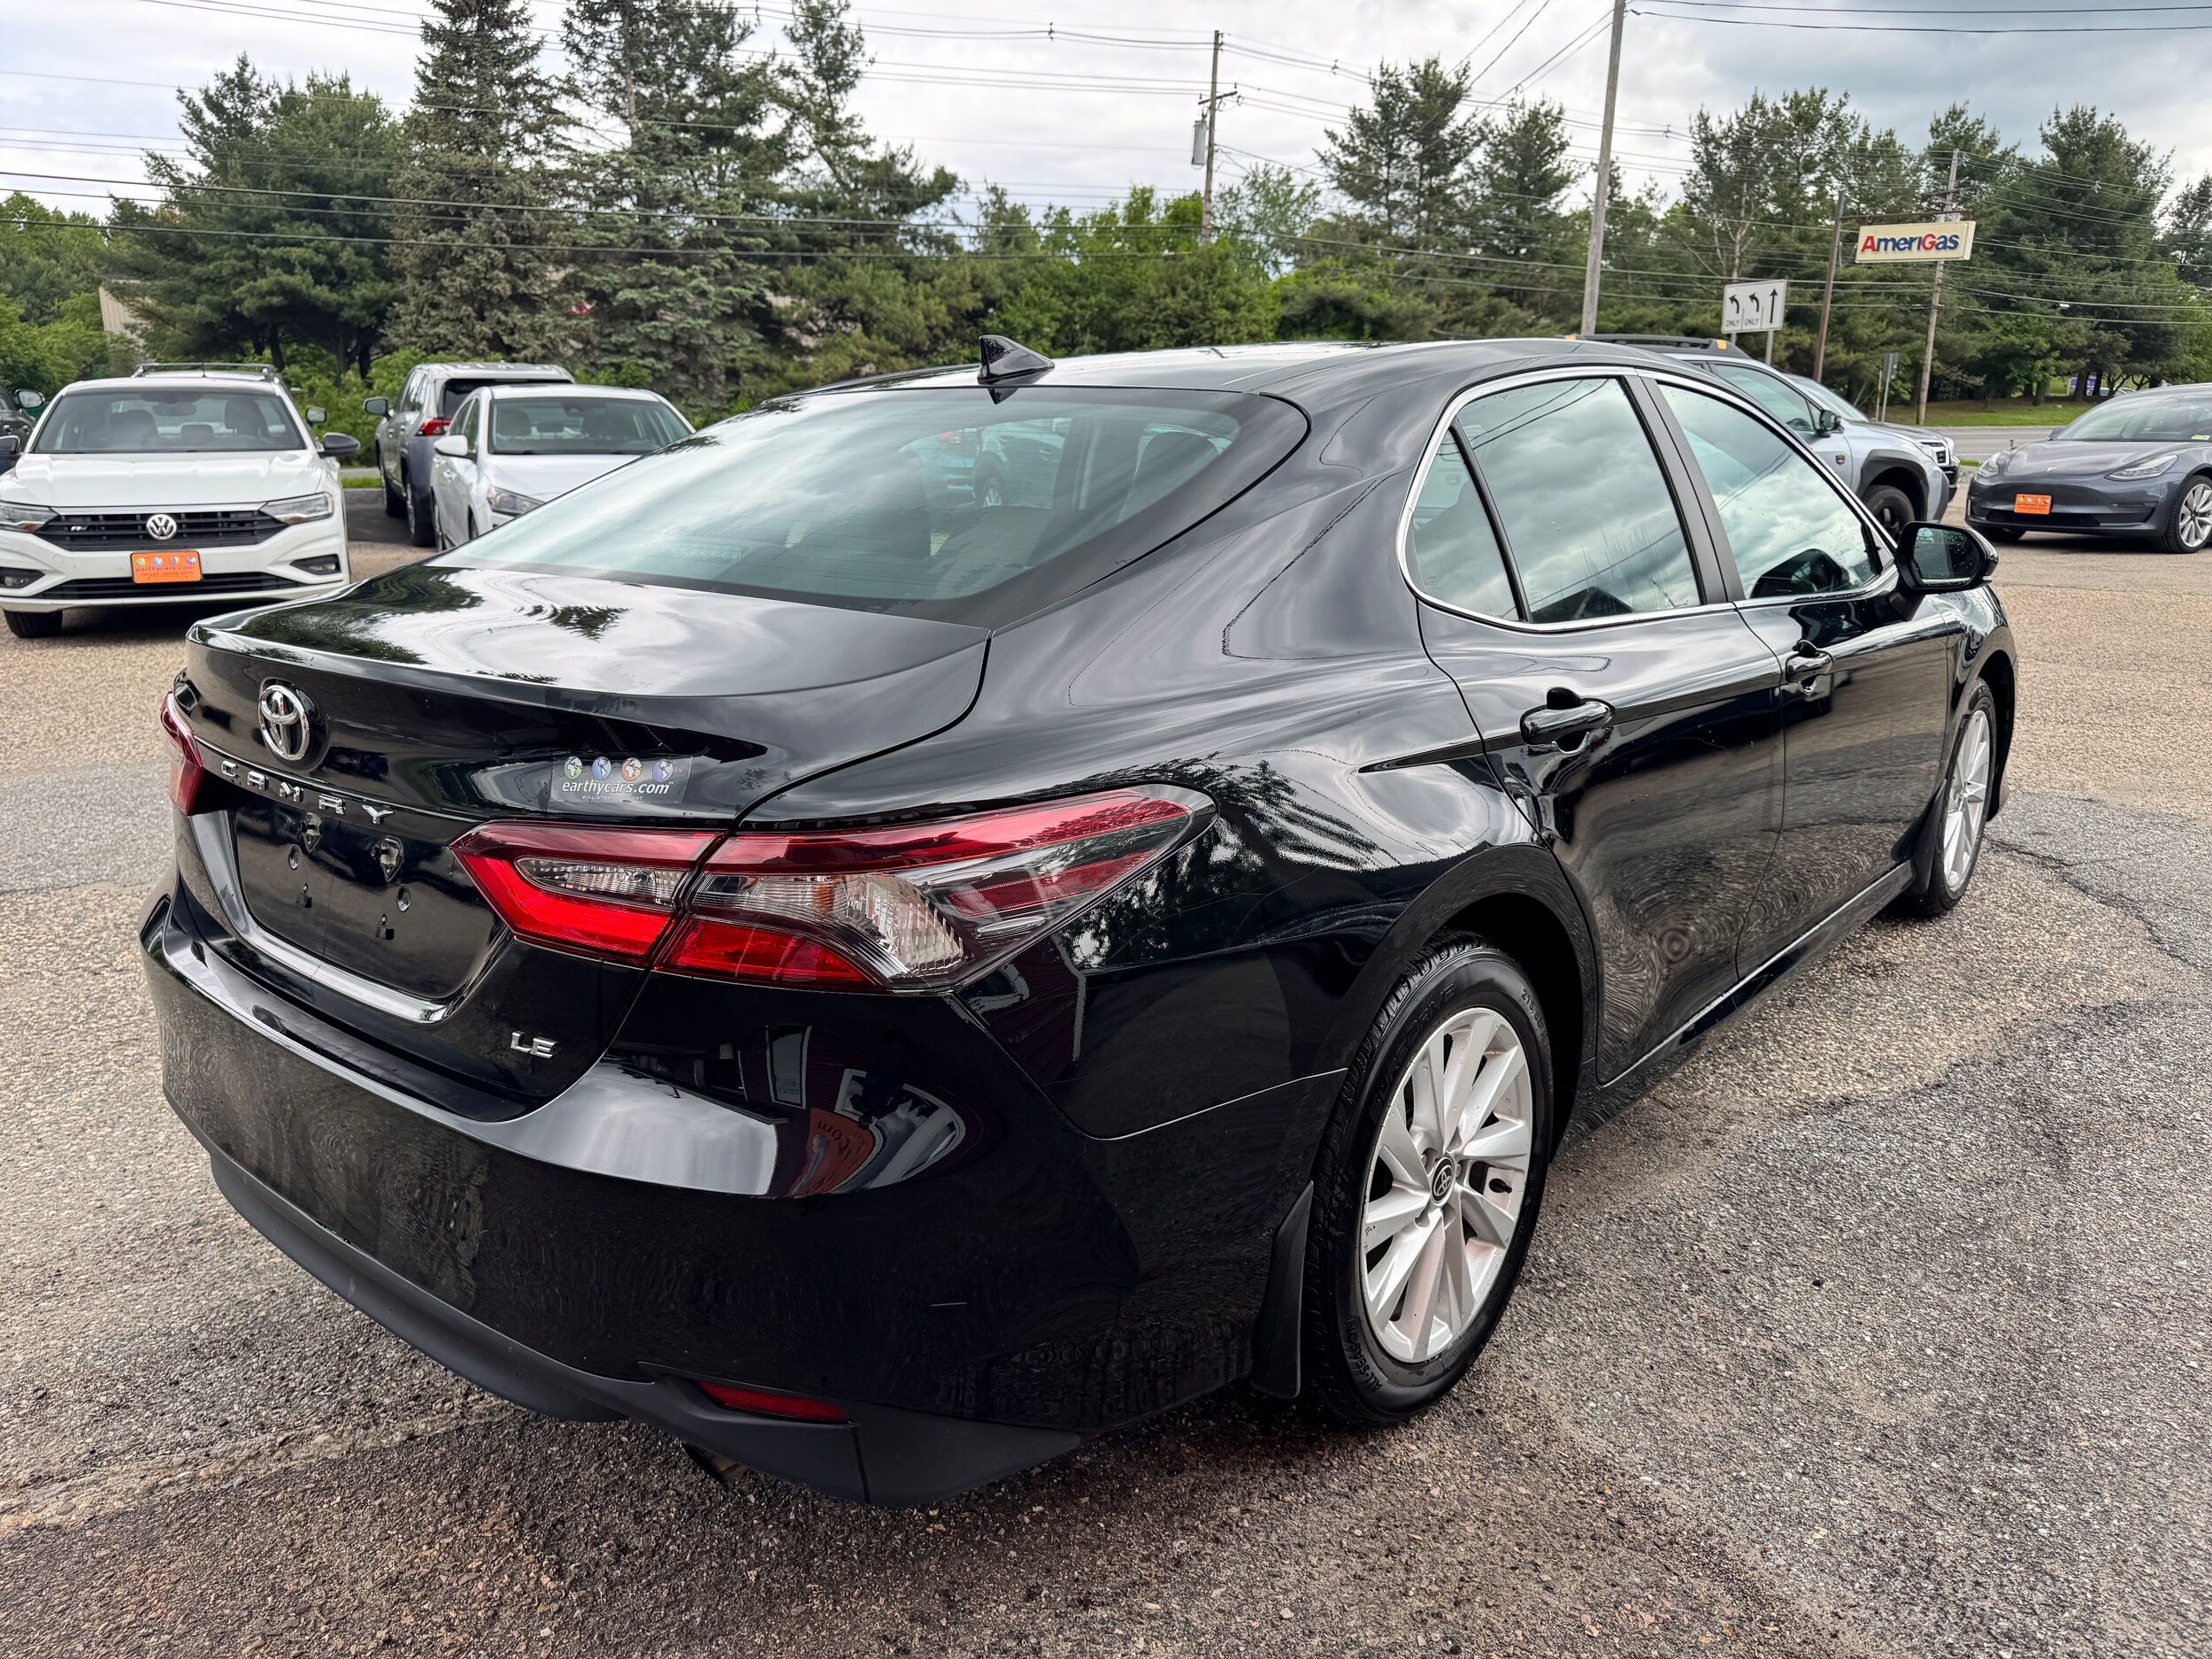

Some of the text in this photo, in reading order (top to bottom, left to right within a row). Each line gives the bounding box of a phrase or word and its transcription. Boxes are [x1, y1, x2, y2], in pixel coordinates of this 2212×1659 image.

[1860, 233, 1960, 253] AmeriGas
[1745, 318, 1760, 326] ONLY
[221, 760, 396, 826] CAMRY
[562, 780, 670, 795] earthycars.com
[510, 1030, 558, 1059] LE
